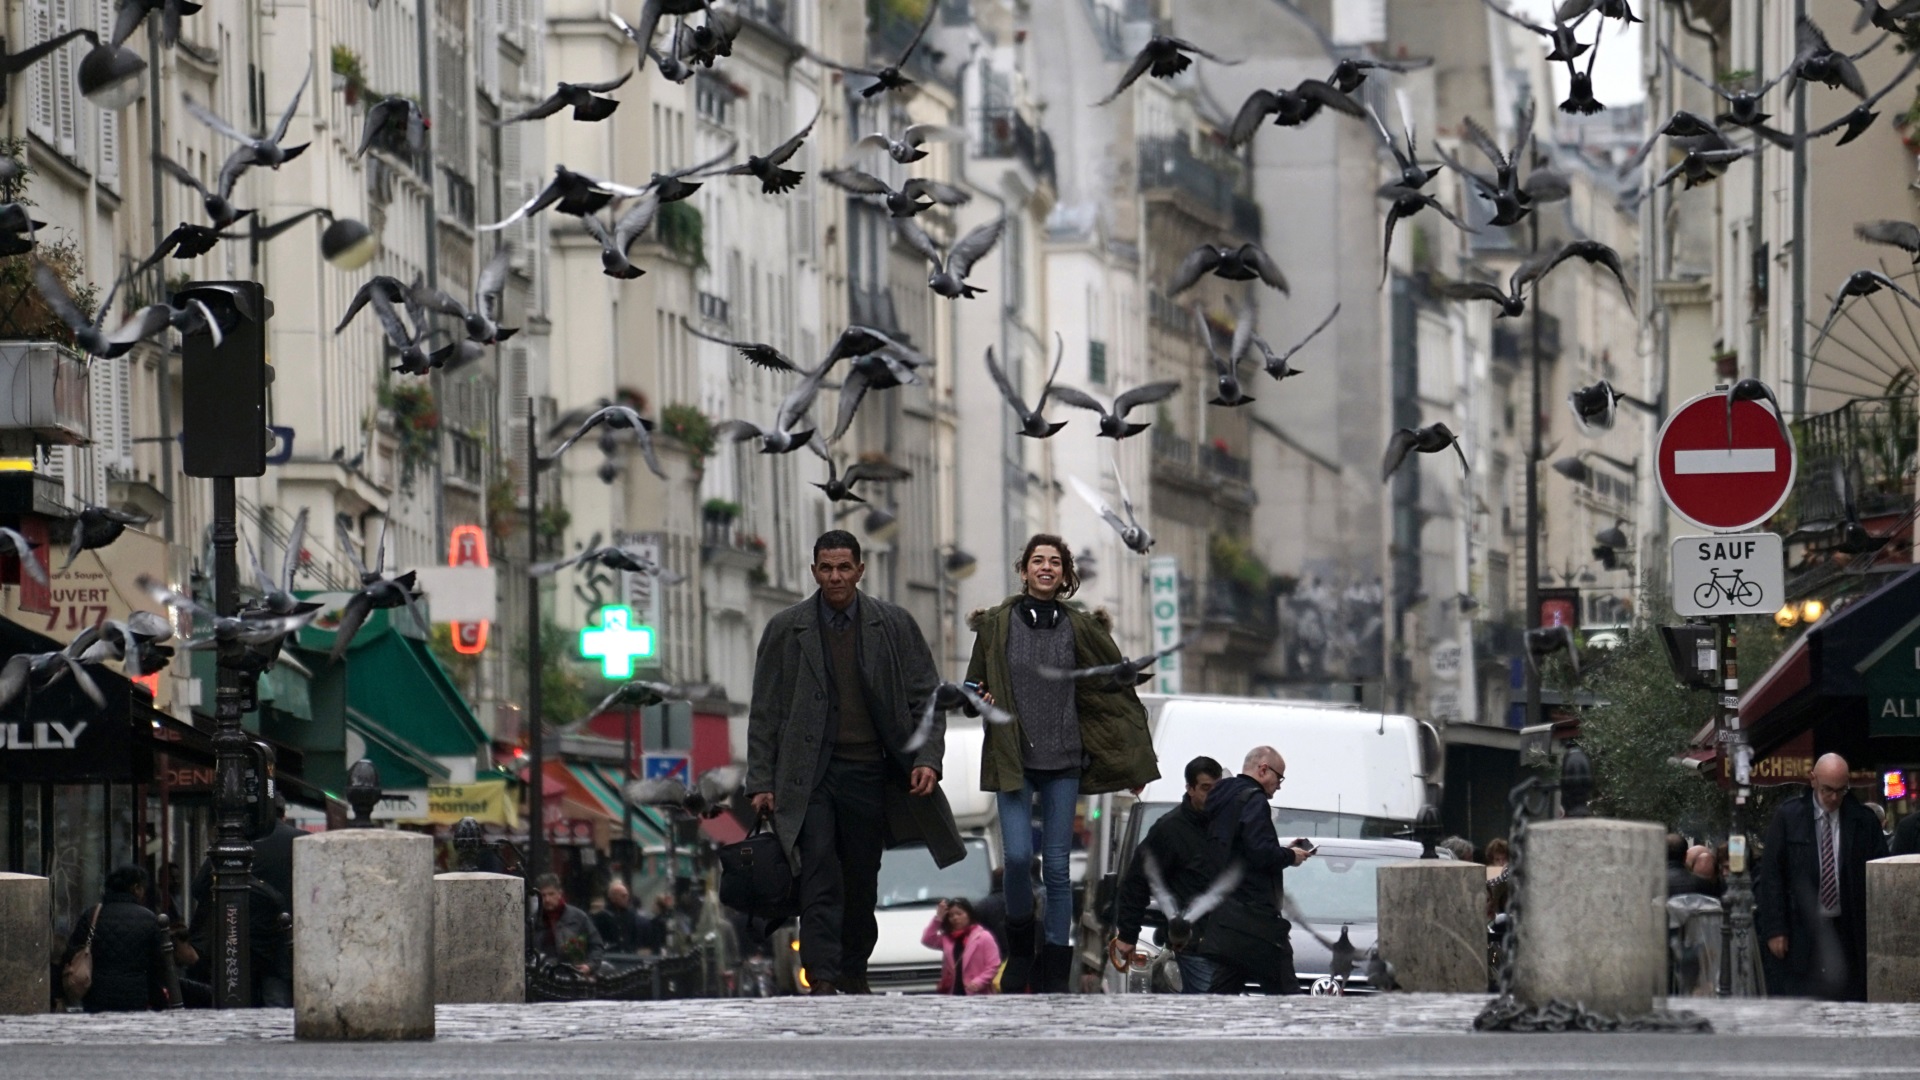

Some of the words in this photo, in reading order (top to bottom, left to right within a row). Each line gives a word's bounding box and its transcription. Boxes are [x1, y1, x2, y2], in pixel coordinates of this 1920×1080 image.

[1698, 541, 1756, 560] SAUF
[51, 572, 62, 580] ar
[74, 571, 104, 581] Soupe
[50, 588, 109, 602] UVERT
[1153, 576, 1176, 695] HOTEL
